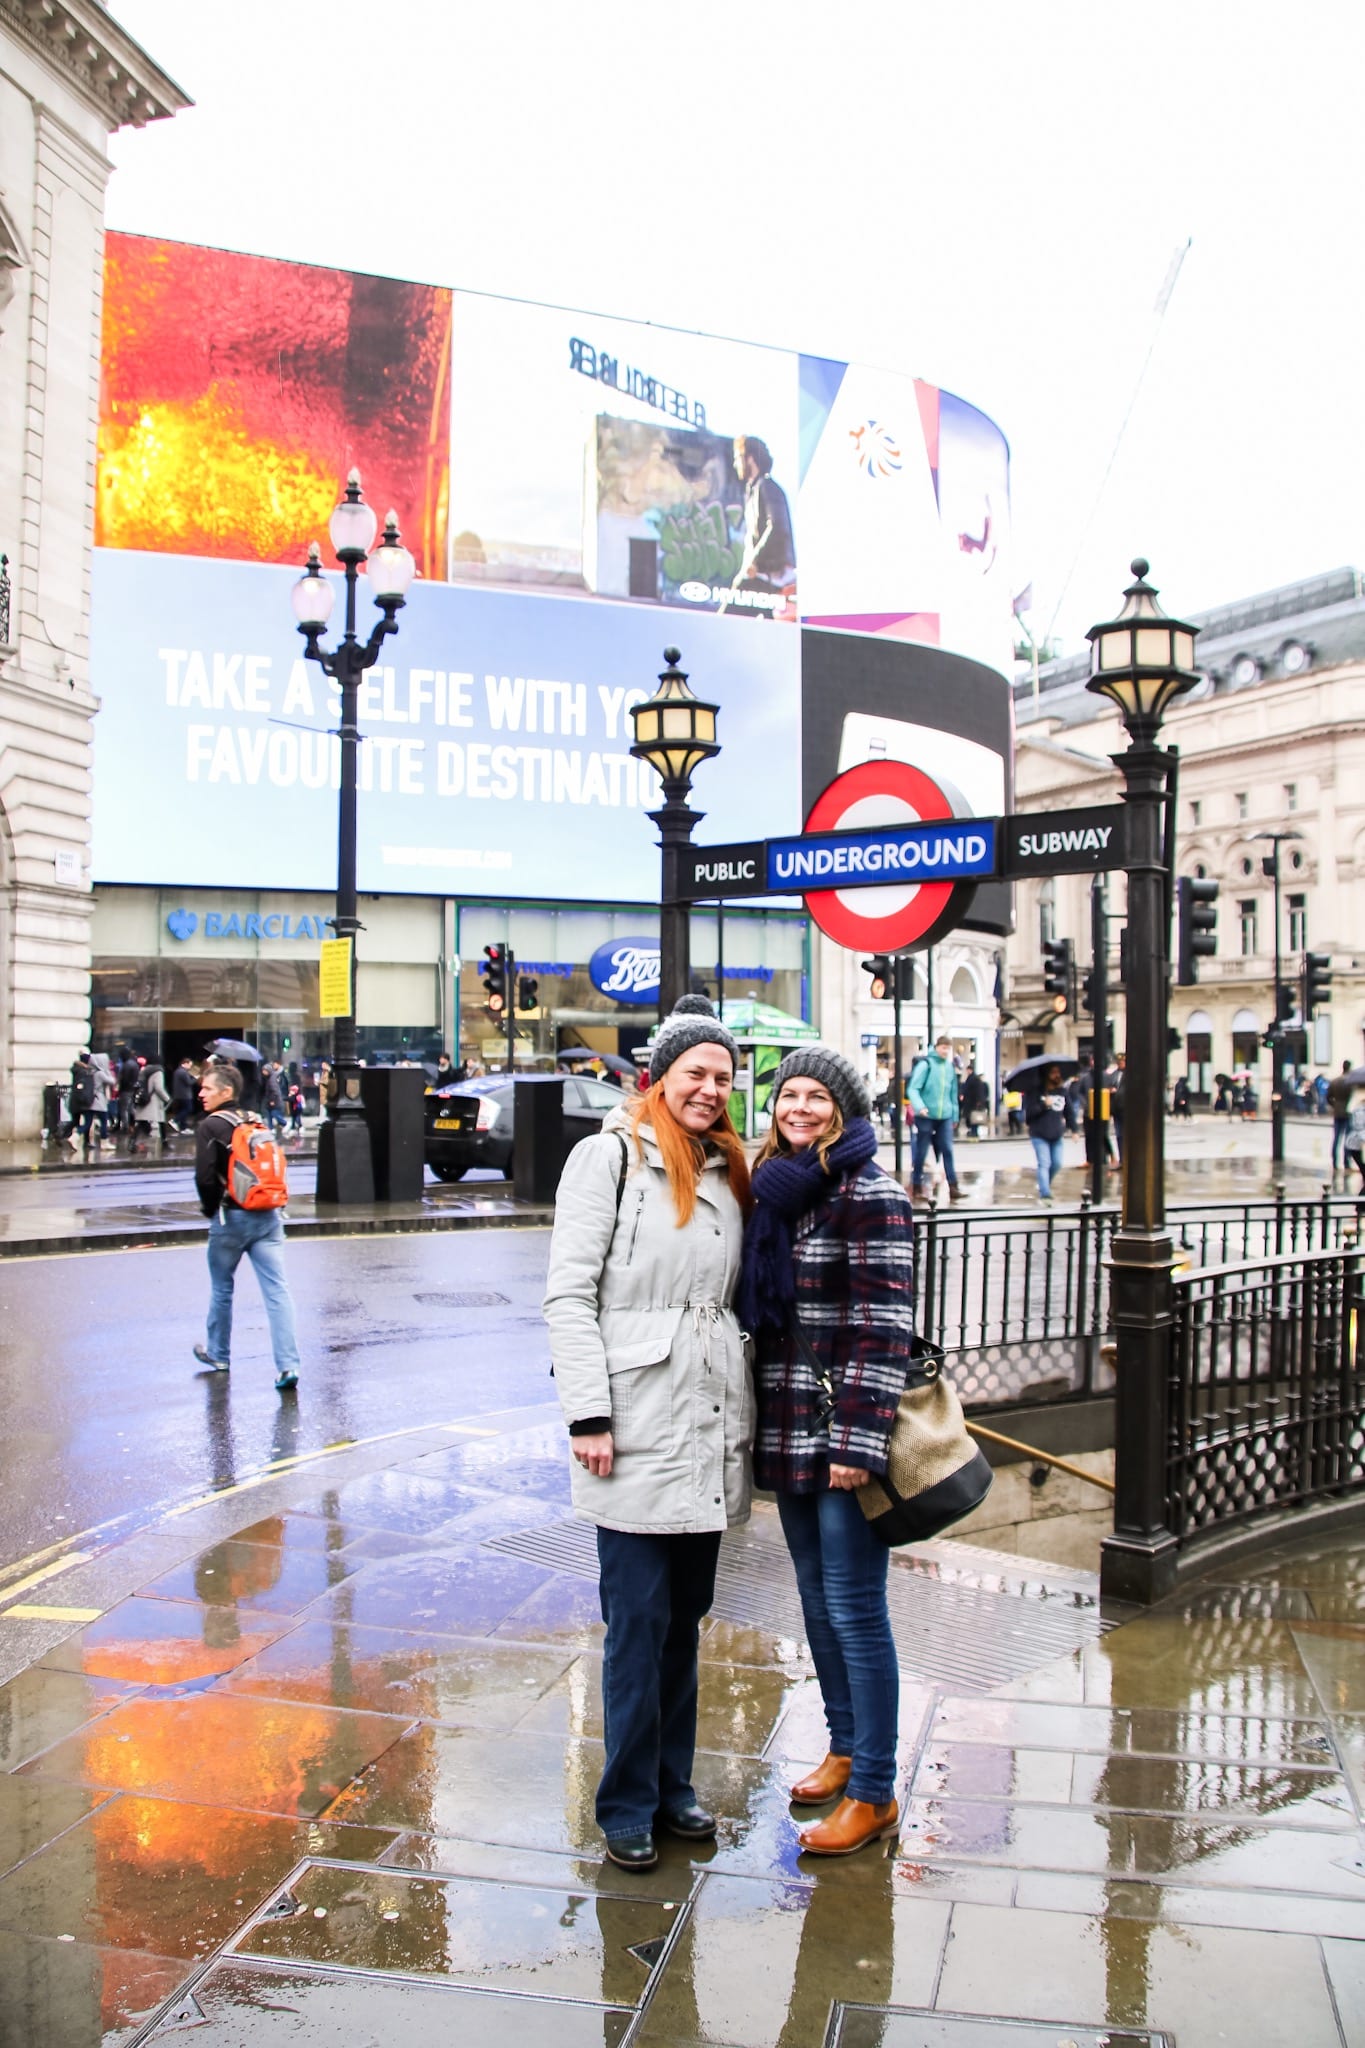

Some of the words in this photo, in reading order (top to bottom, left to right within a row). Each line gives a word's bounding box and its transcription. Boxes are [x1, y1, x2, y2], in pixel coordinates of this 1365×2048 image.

[158, 648, 271, 713] TAKE
[282, 660, 314, 715] A
[485, 676, 586, 735] WITH
[598, 686, 654, 739] YO
[438, 741, 691, 809] DESTINATIO
[775, 835, 987, 879] UNDERGROUND
[1018, 826, 1113, 856] SUBWAY
[694, 860, 756, 883] PUBLIC
[205, 912, 337, 940] BARCLAY
[477, 961, 575, 980] prmacy
[601, 946, 661, 993] Boo
